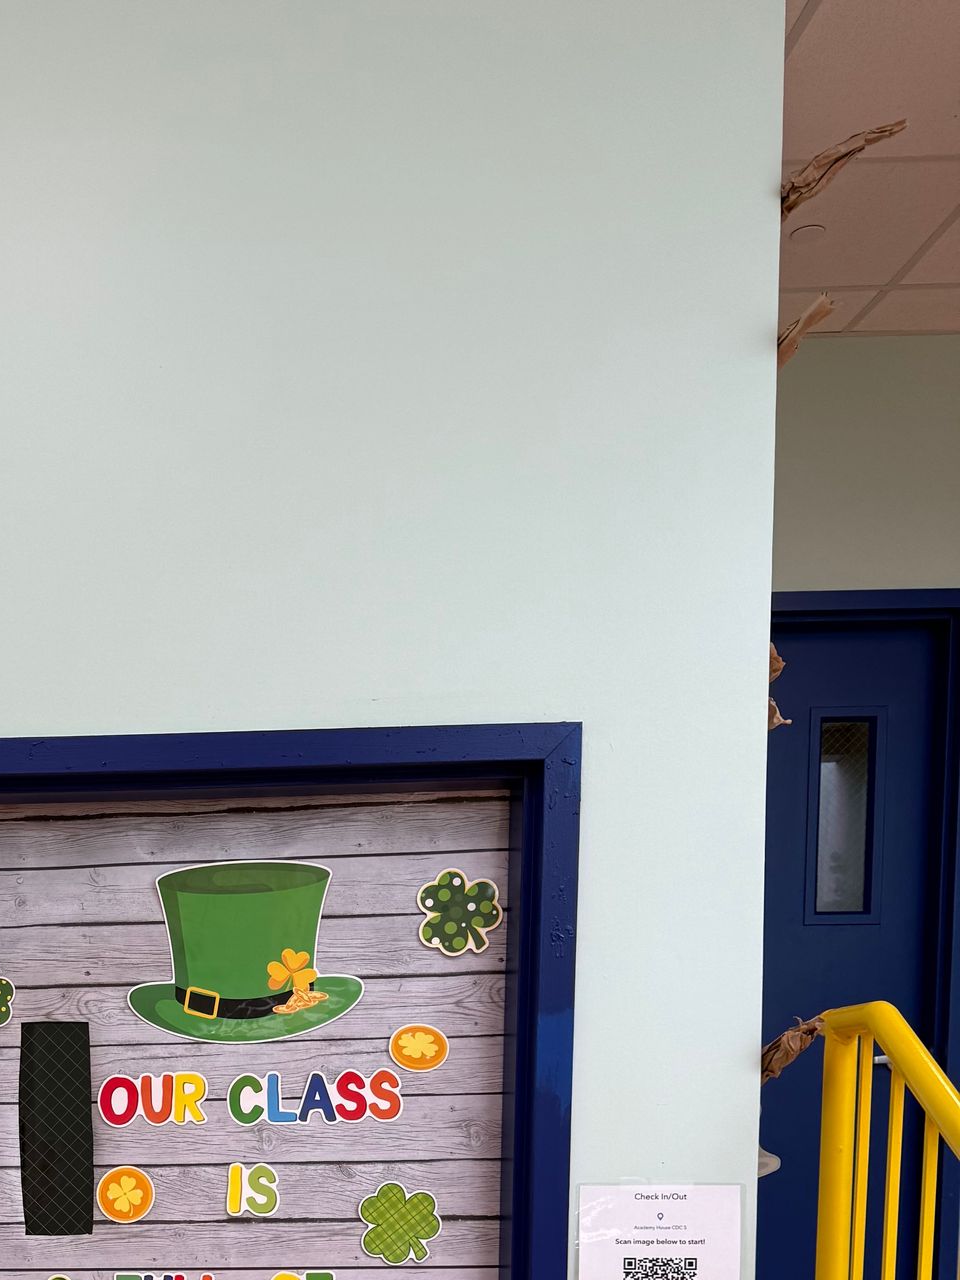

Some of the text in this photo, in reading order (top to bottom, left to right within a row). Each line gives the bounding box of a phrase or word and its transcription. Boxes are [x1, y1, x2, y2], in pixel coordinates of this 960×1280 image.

[97, 1069, 404, 1127] OUR CLASS
[226, 1164, 278, 1216] IS
